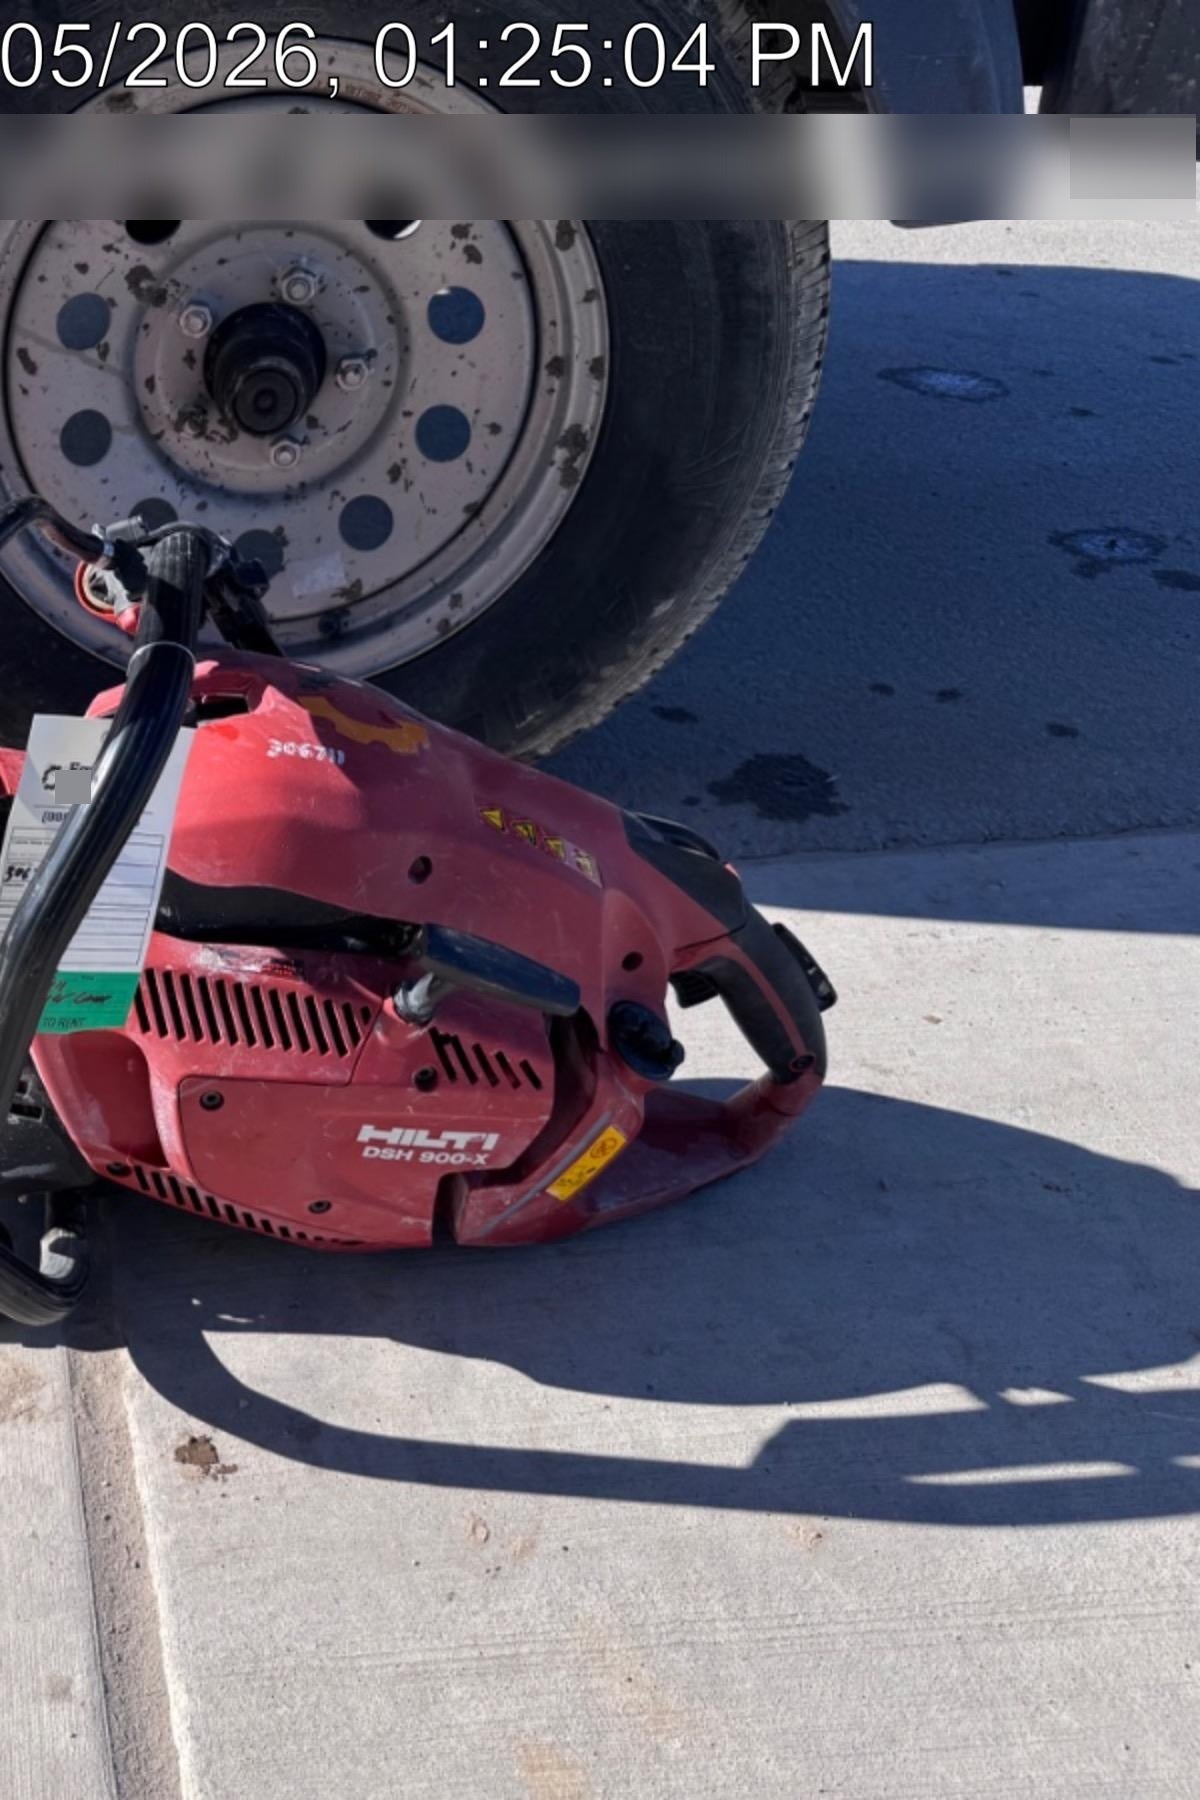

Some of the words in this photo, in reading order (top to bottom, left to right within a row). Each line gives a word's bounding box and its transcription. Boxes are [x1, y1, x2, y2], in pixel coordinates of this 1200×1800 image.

[356, 1124, 500, 1151] HILTI
[362, 1146, 414, 1161] DSH
[419, 1151, 489, 1165] 900-X
